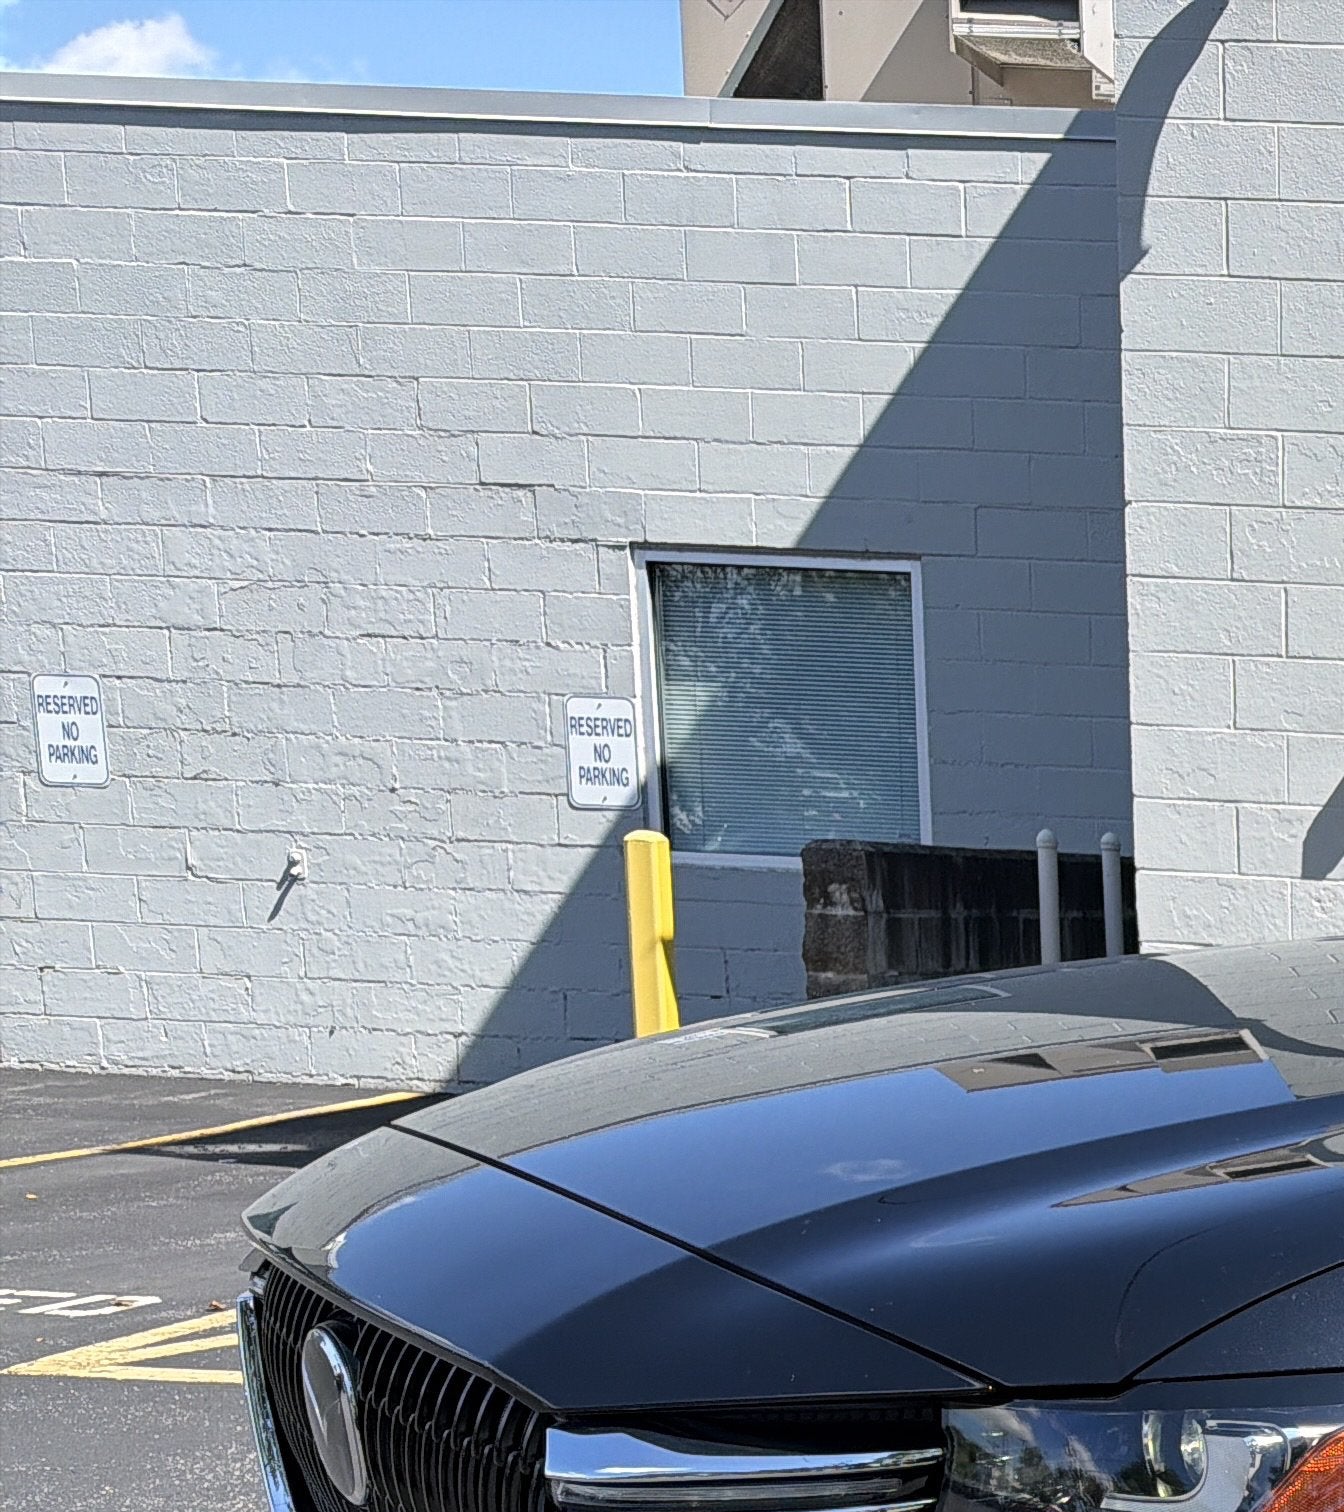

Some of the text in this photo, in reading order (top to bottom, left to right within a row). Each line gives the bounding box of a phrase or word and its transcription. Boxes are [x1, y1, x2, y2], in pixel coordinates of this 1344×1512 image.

[36, 694, 99, 716] RESERVED
[61, 721, 80, 742] NO
[569, 716, 633, 738] RESERVED
[47, 743, 99, 765] PARKING
[593, 743, 611, 764] NO
[578, 766, 630, 787] PARKING
